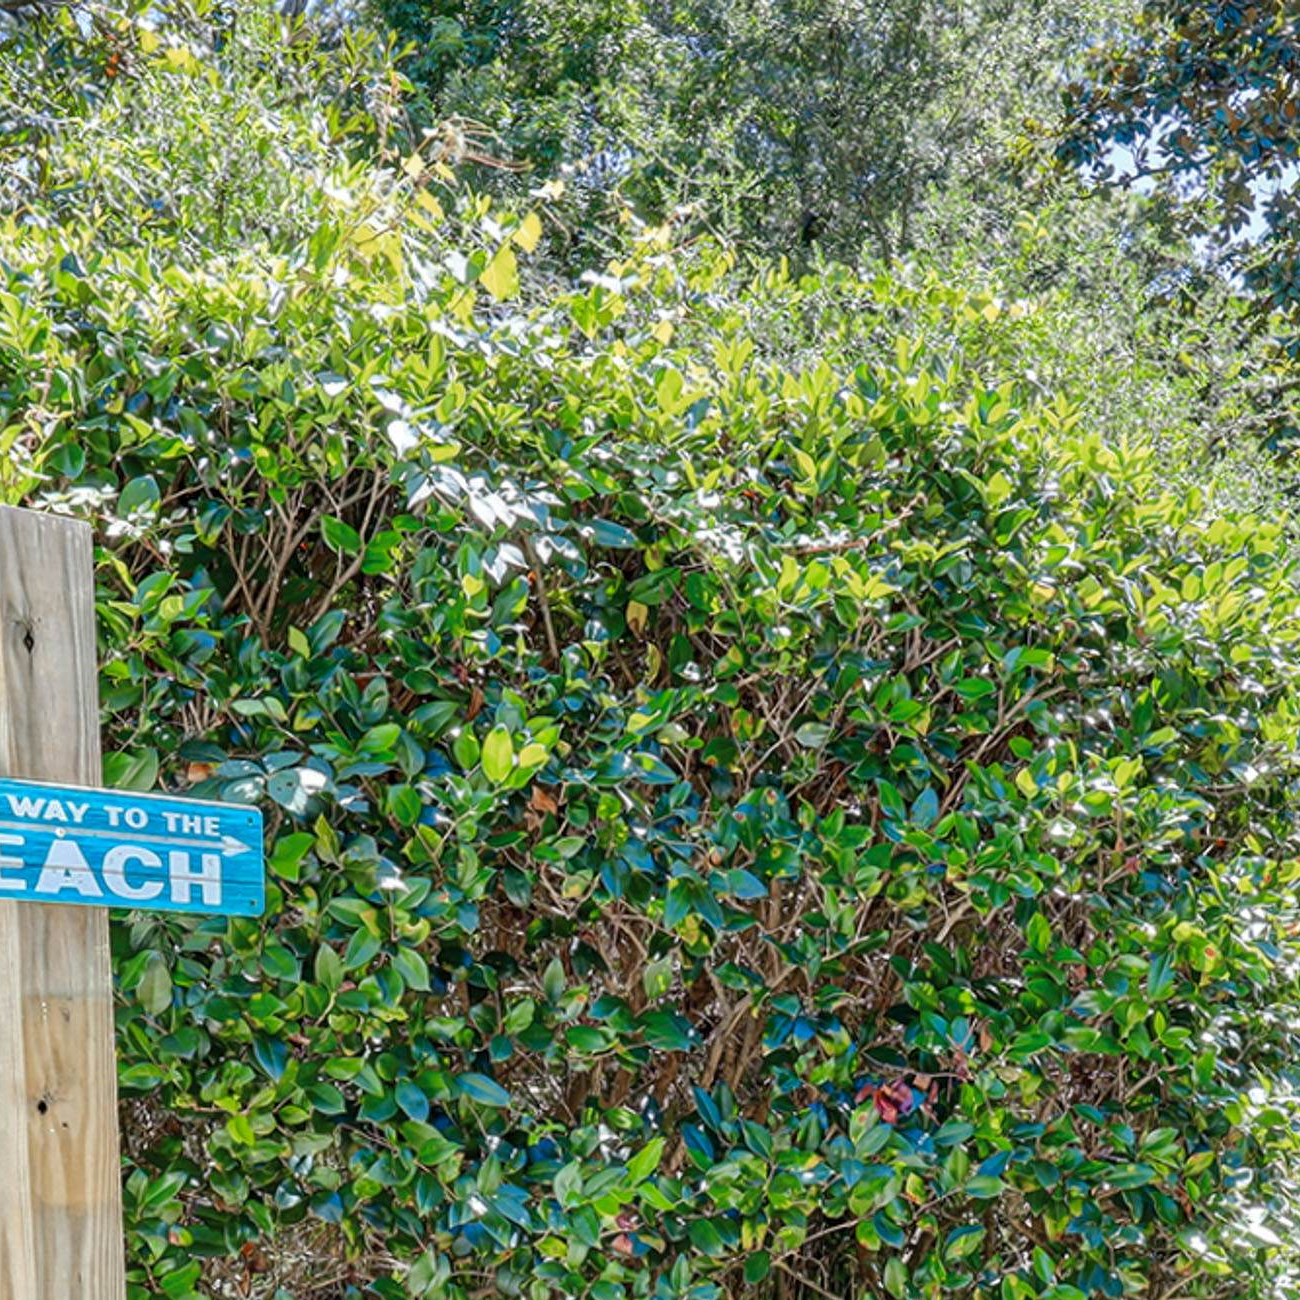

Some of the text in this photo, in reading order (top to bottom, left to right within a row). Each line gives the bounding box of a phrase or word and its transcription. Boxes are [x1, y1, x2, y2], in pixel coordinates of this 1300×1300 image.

[6, 794, 90, 823] WAY
[104, 805, 149, 829] TO
[162, 812, 221, 836] THE
